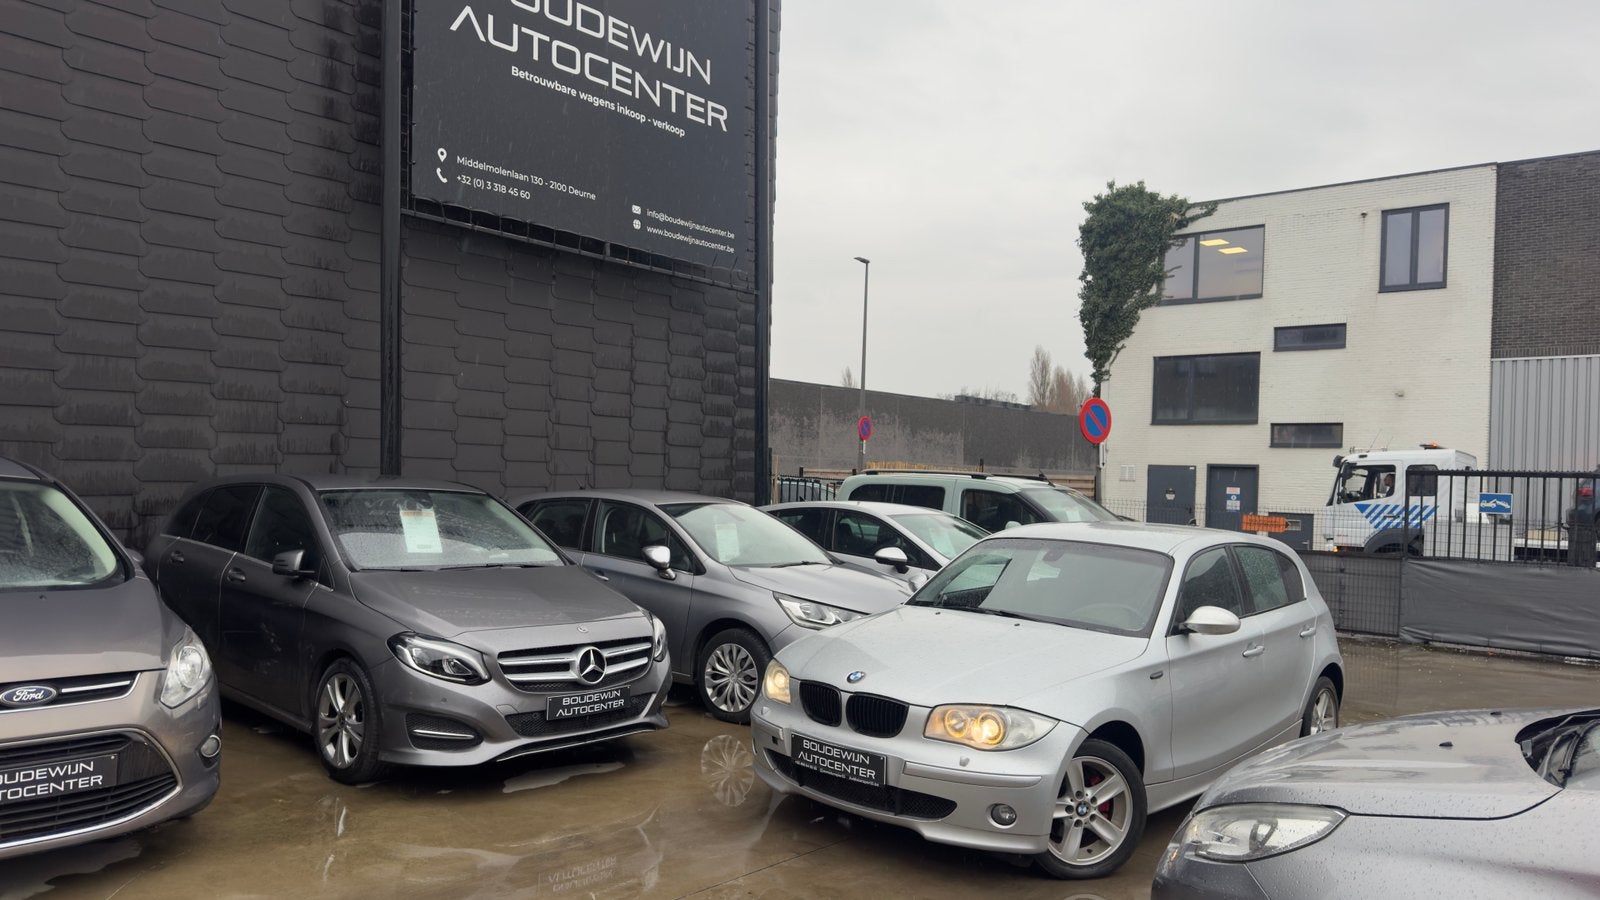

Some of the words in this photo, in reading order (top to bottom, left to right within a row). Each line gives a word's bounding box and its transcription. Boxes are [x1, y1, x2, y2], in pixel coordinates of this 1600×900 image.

[450, 5, 728, 132] AUTOCENTER
[511, 65, 577, 97] Betrouwbare
[579, 91, 616, 111] wagens
[617, 102, 646, 123] inkoop
[652, 117, 685, 138] verkoop
[456, 155, 529, 182] Middelmolenlaan
[531, 175, 543, 186] 130
[549, 180, 567, 192] 2100
[568, 185, 596, 200] Deurne
[456, 174, 472, 185] +32
[473, 178, 484, 190] (0)
[486, 181, 492, 190] 3
[493, 182, 507, 194] 318
[508, 186, 519, 197] 45
[520, 189, 531, 200] 60
[646, 208, 735, 239] info@boudewijnautocenter.be
[646, 226, 735, 254] www.boudewijnautocenter.be
[12, 689, 44, 702] Ford
[556, 698, 625, 717] AUTOCENTER
[562, 689, 621, 706] BOUDEWIJN
[798, 751, 876, 780] AUTOCENTER
[803, 739, 870, 765] BOUDEWIJN
[0, 761, 94, 785] UDEWIJN
